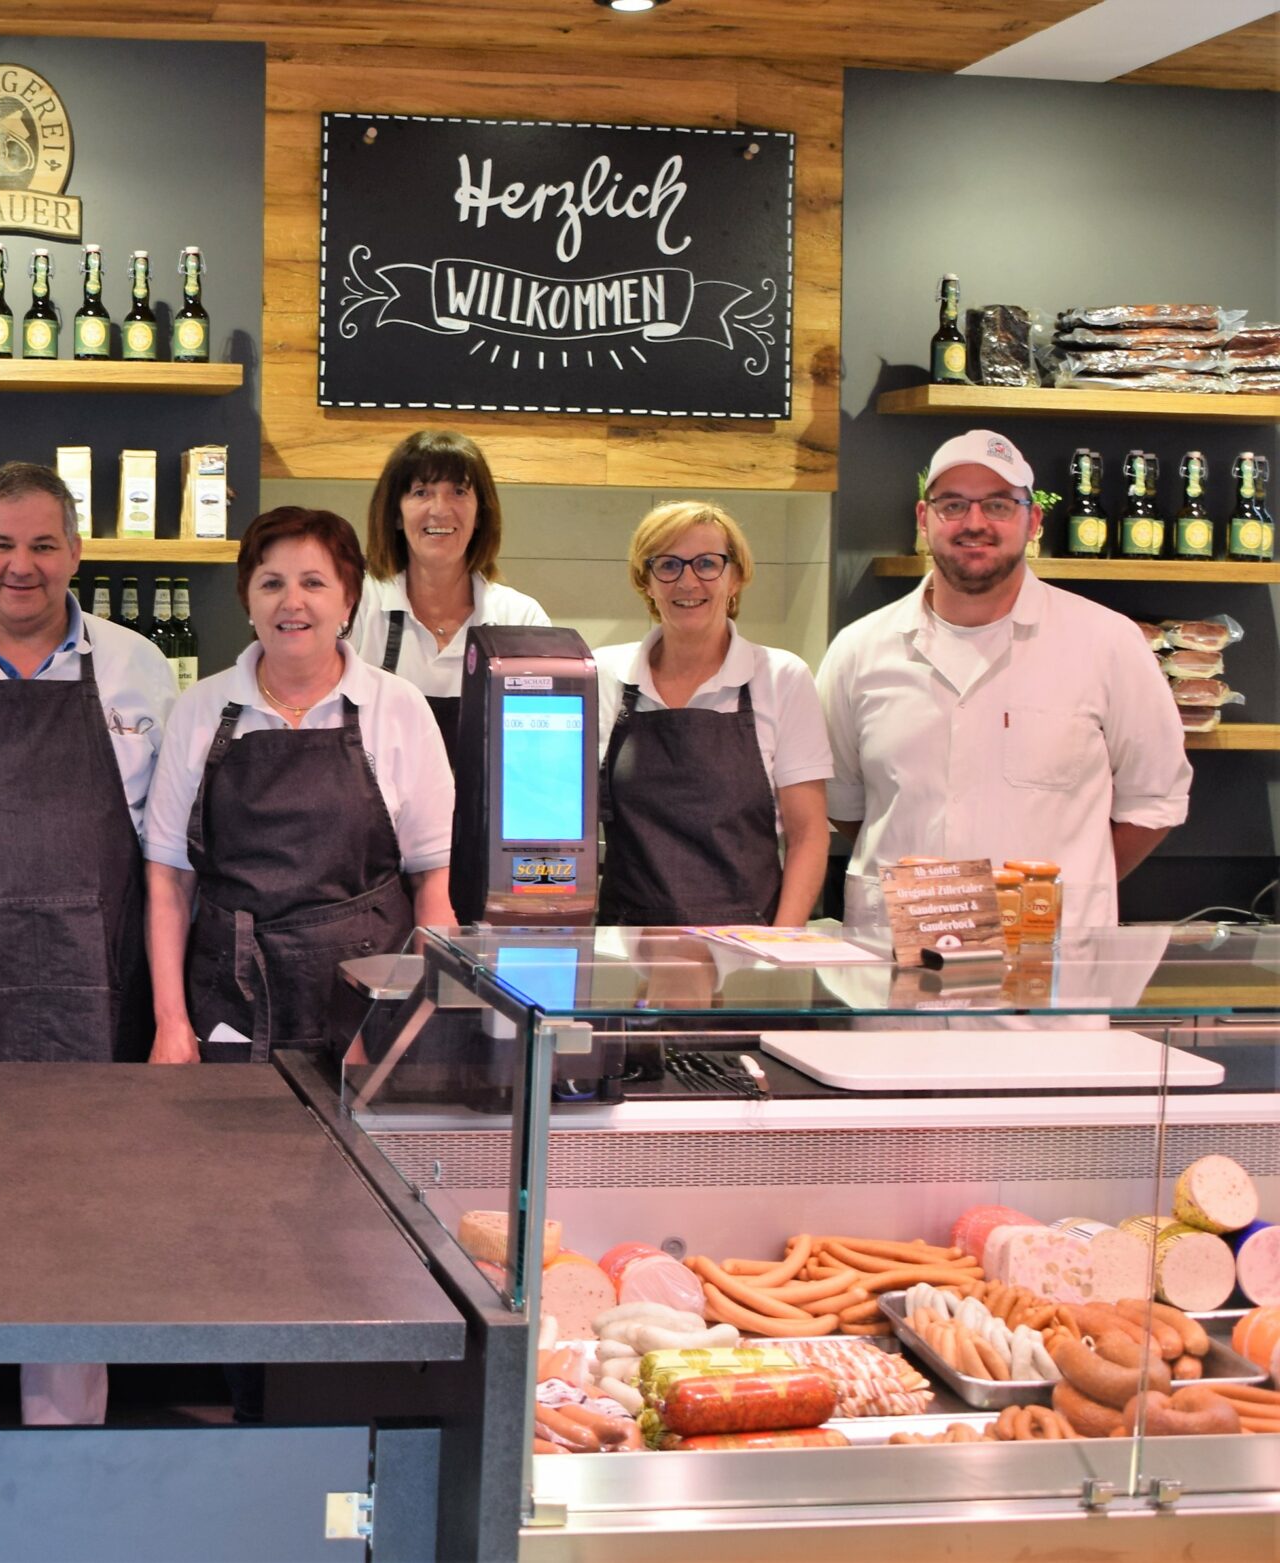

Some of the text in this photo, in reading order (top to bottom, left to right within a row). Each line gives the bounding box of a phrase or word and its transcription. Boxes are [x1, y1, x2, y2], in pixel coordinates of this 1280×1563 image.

[454, 154, 691, 263] Herzlich
[446, 267, 666, 331] WILLKOMMEN
[517, 863, 573, 876] SCHATZ
[914, 864, 960, 876] Ab sofort:
[897, 883, 984, 900] Original Zillertaler
[909, 900, 978, 916] Gauderwurst &
[919, 918, 976, 932] Gauderbock
